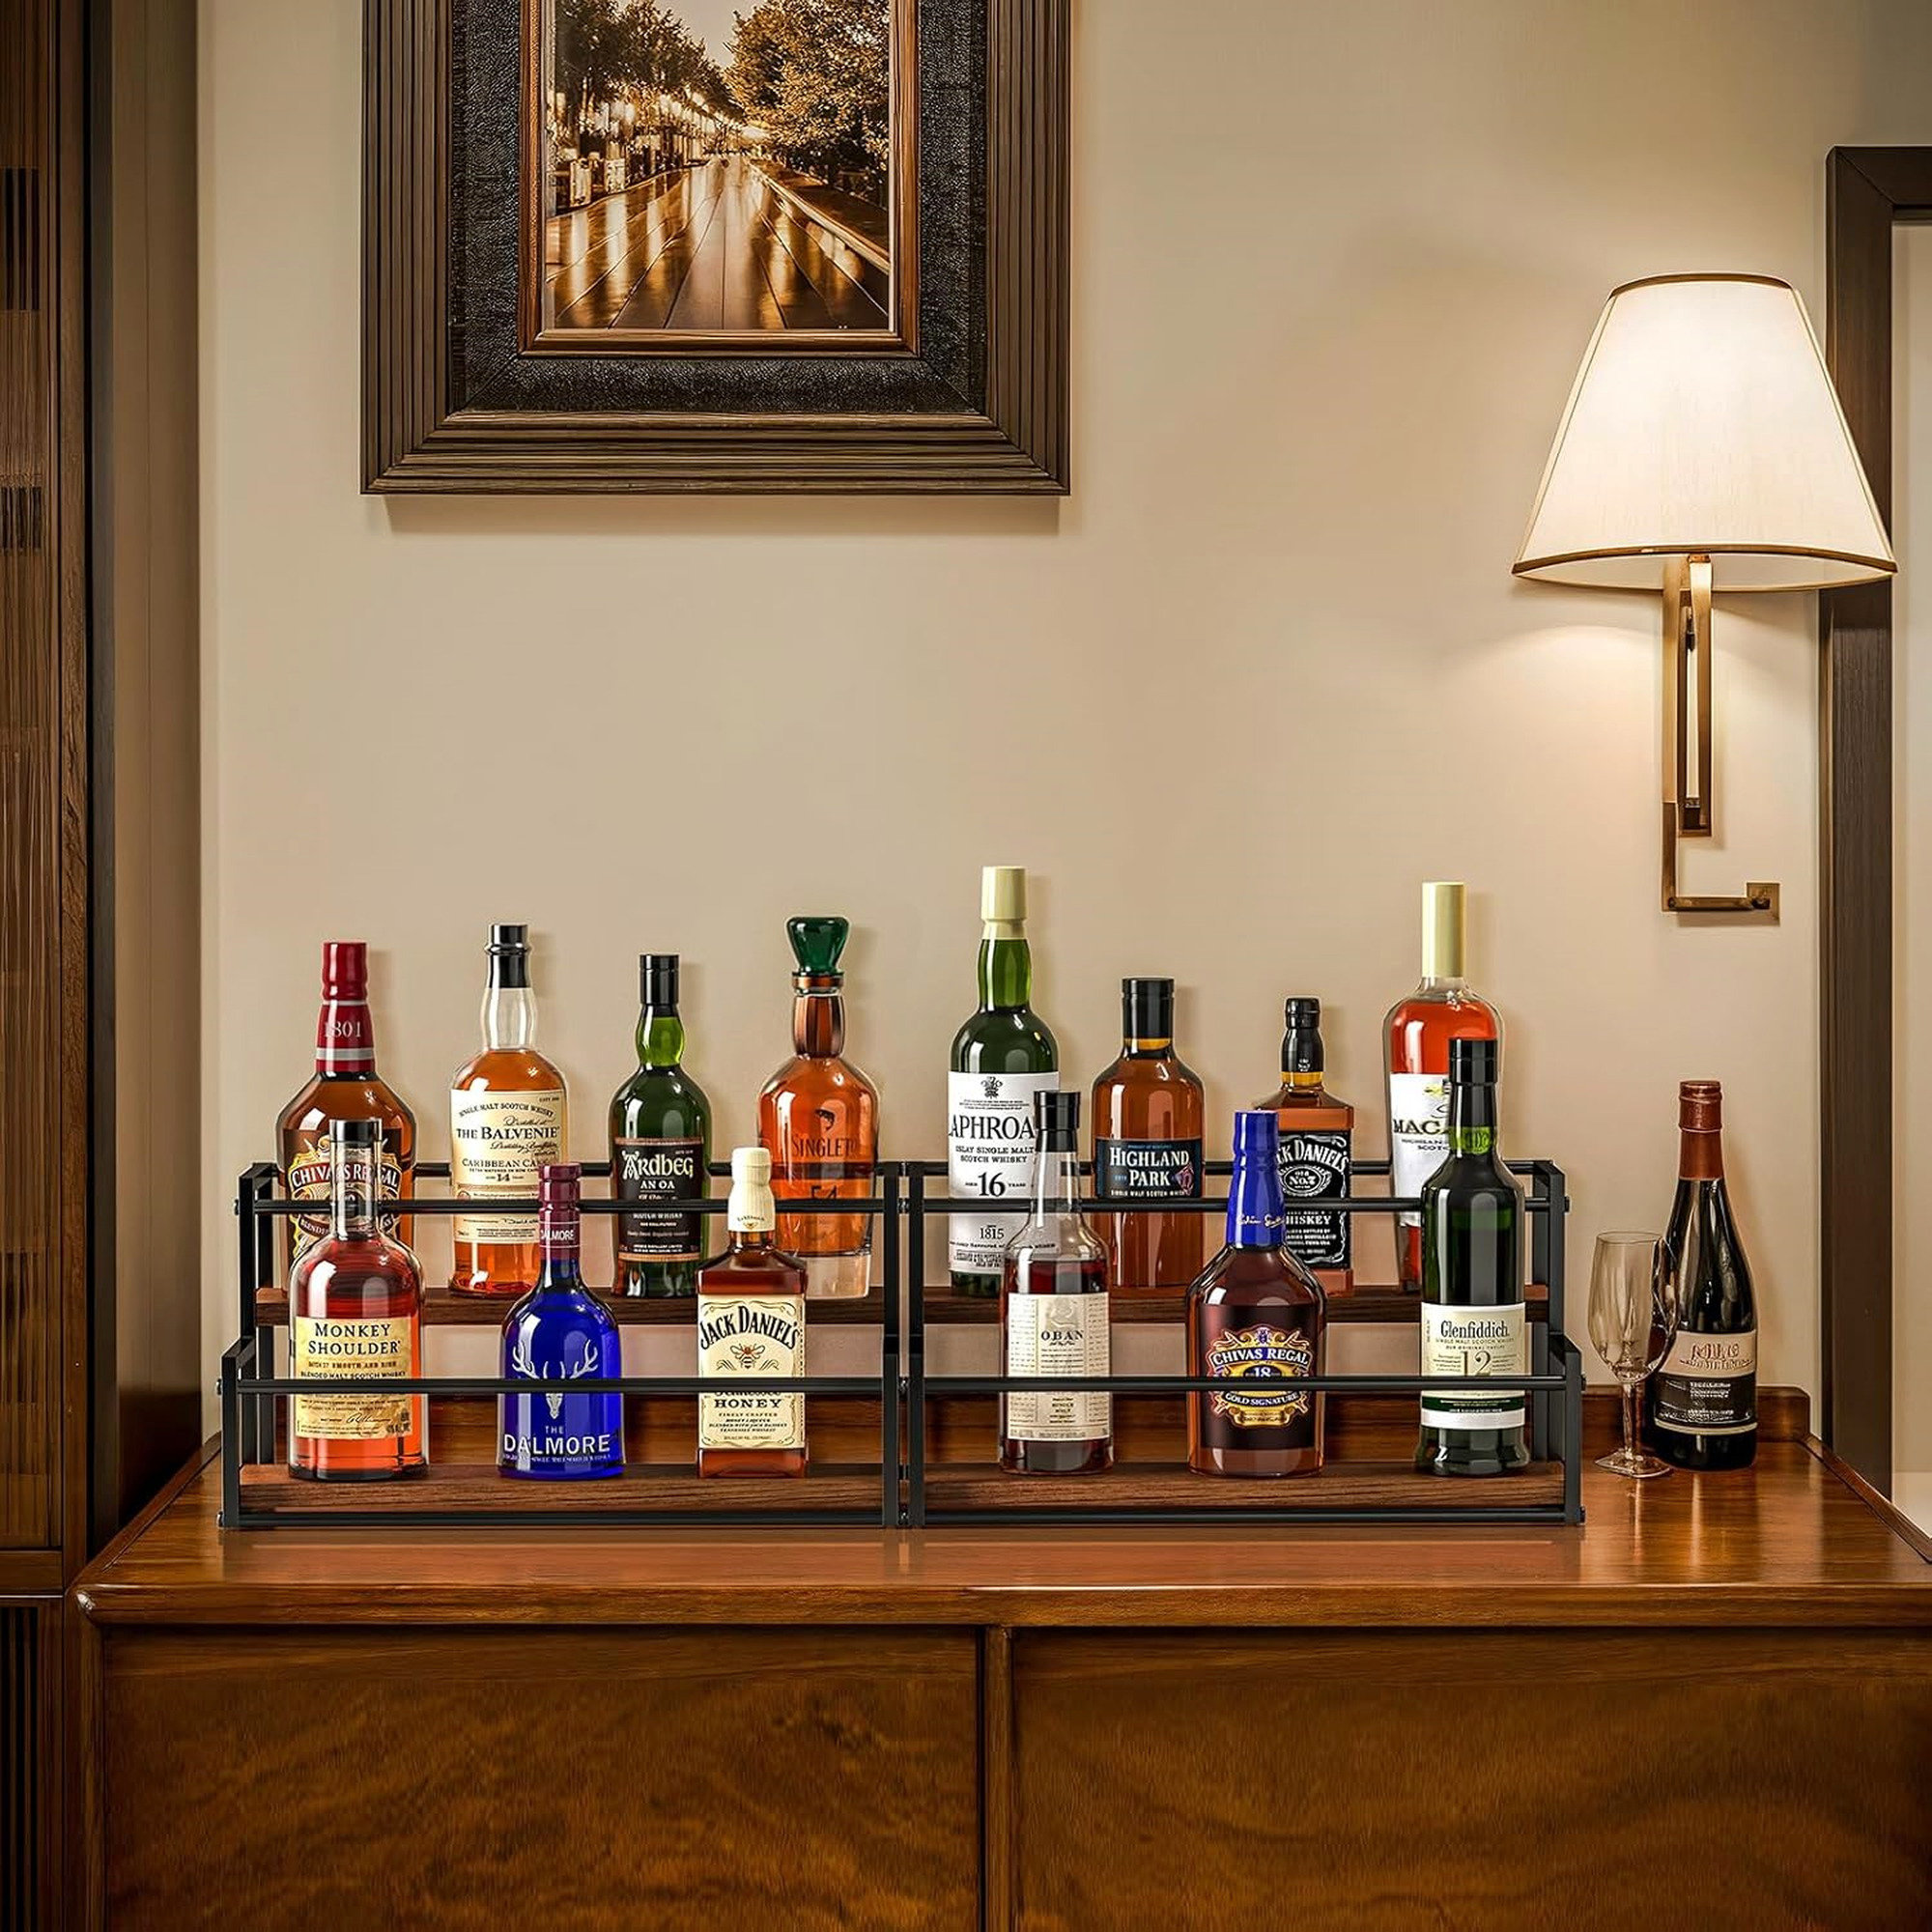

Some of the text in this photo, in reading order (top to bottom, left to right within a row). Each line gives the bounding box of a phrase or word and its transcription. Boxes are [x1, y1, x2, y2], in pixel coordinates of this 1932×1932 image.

[456, 1125, 558, 1141] THE BALVENIE
[949, 1115, 1035, 1140] APHROA
[462, 1158, 521, 1169] CARIBBEAN
[991, 1155, 1028, 1164] WHISKY
[1110, 1147, 1190, 1167] HIGHLAND
[1276, 1139, 1349, 1174] CK DANIEL'S
[639, 1179, 676, 1189] AN OA
[978, 1171, 1006, 1198] 16
[1129, 1169, 1171, 1187] PARK
[980, 1227, 1005, 1240] 1815
[315, 1321, 391, 1338] MONKEY
[700, 1305, 800, 1350] JACK DANIEL'S
[1040, 1329, 1083, 1341] OBAN
[1440, 1320, 1509, 1339] Glenfiddich
[308, 1340, 398, 1355] SHOULDER
[1212, 1348, 1308, 1365] CHIVAS REGAL
[1459, 1350, 1492, 1377] 12
[1254, 1366, 1271, 1378] 18
[714, 1399, 781, 1408] HONEY
[1225, 1391, 1299, 1406] GOLD SIGNATURE
[545, 1425, 564, 1435] THE
[503, 1434, 611, 1455] DALMORE
